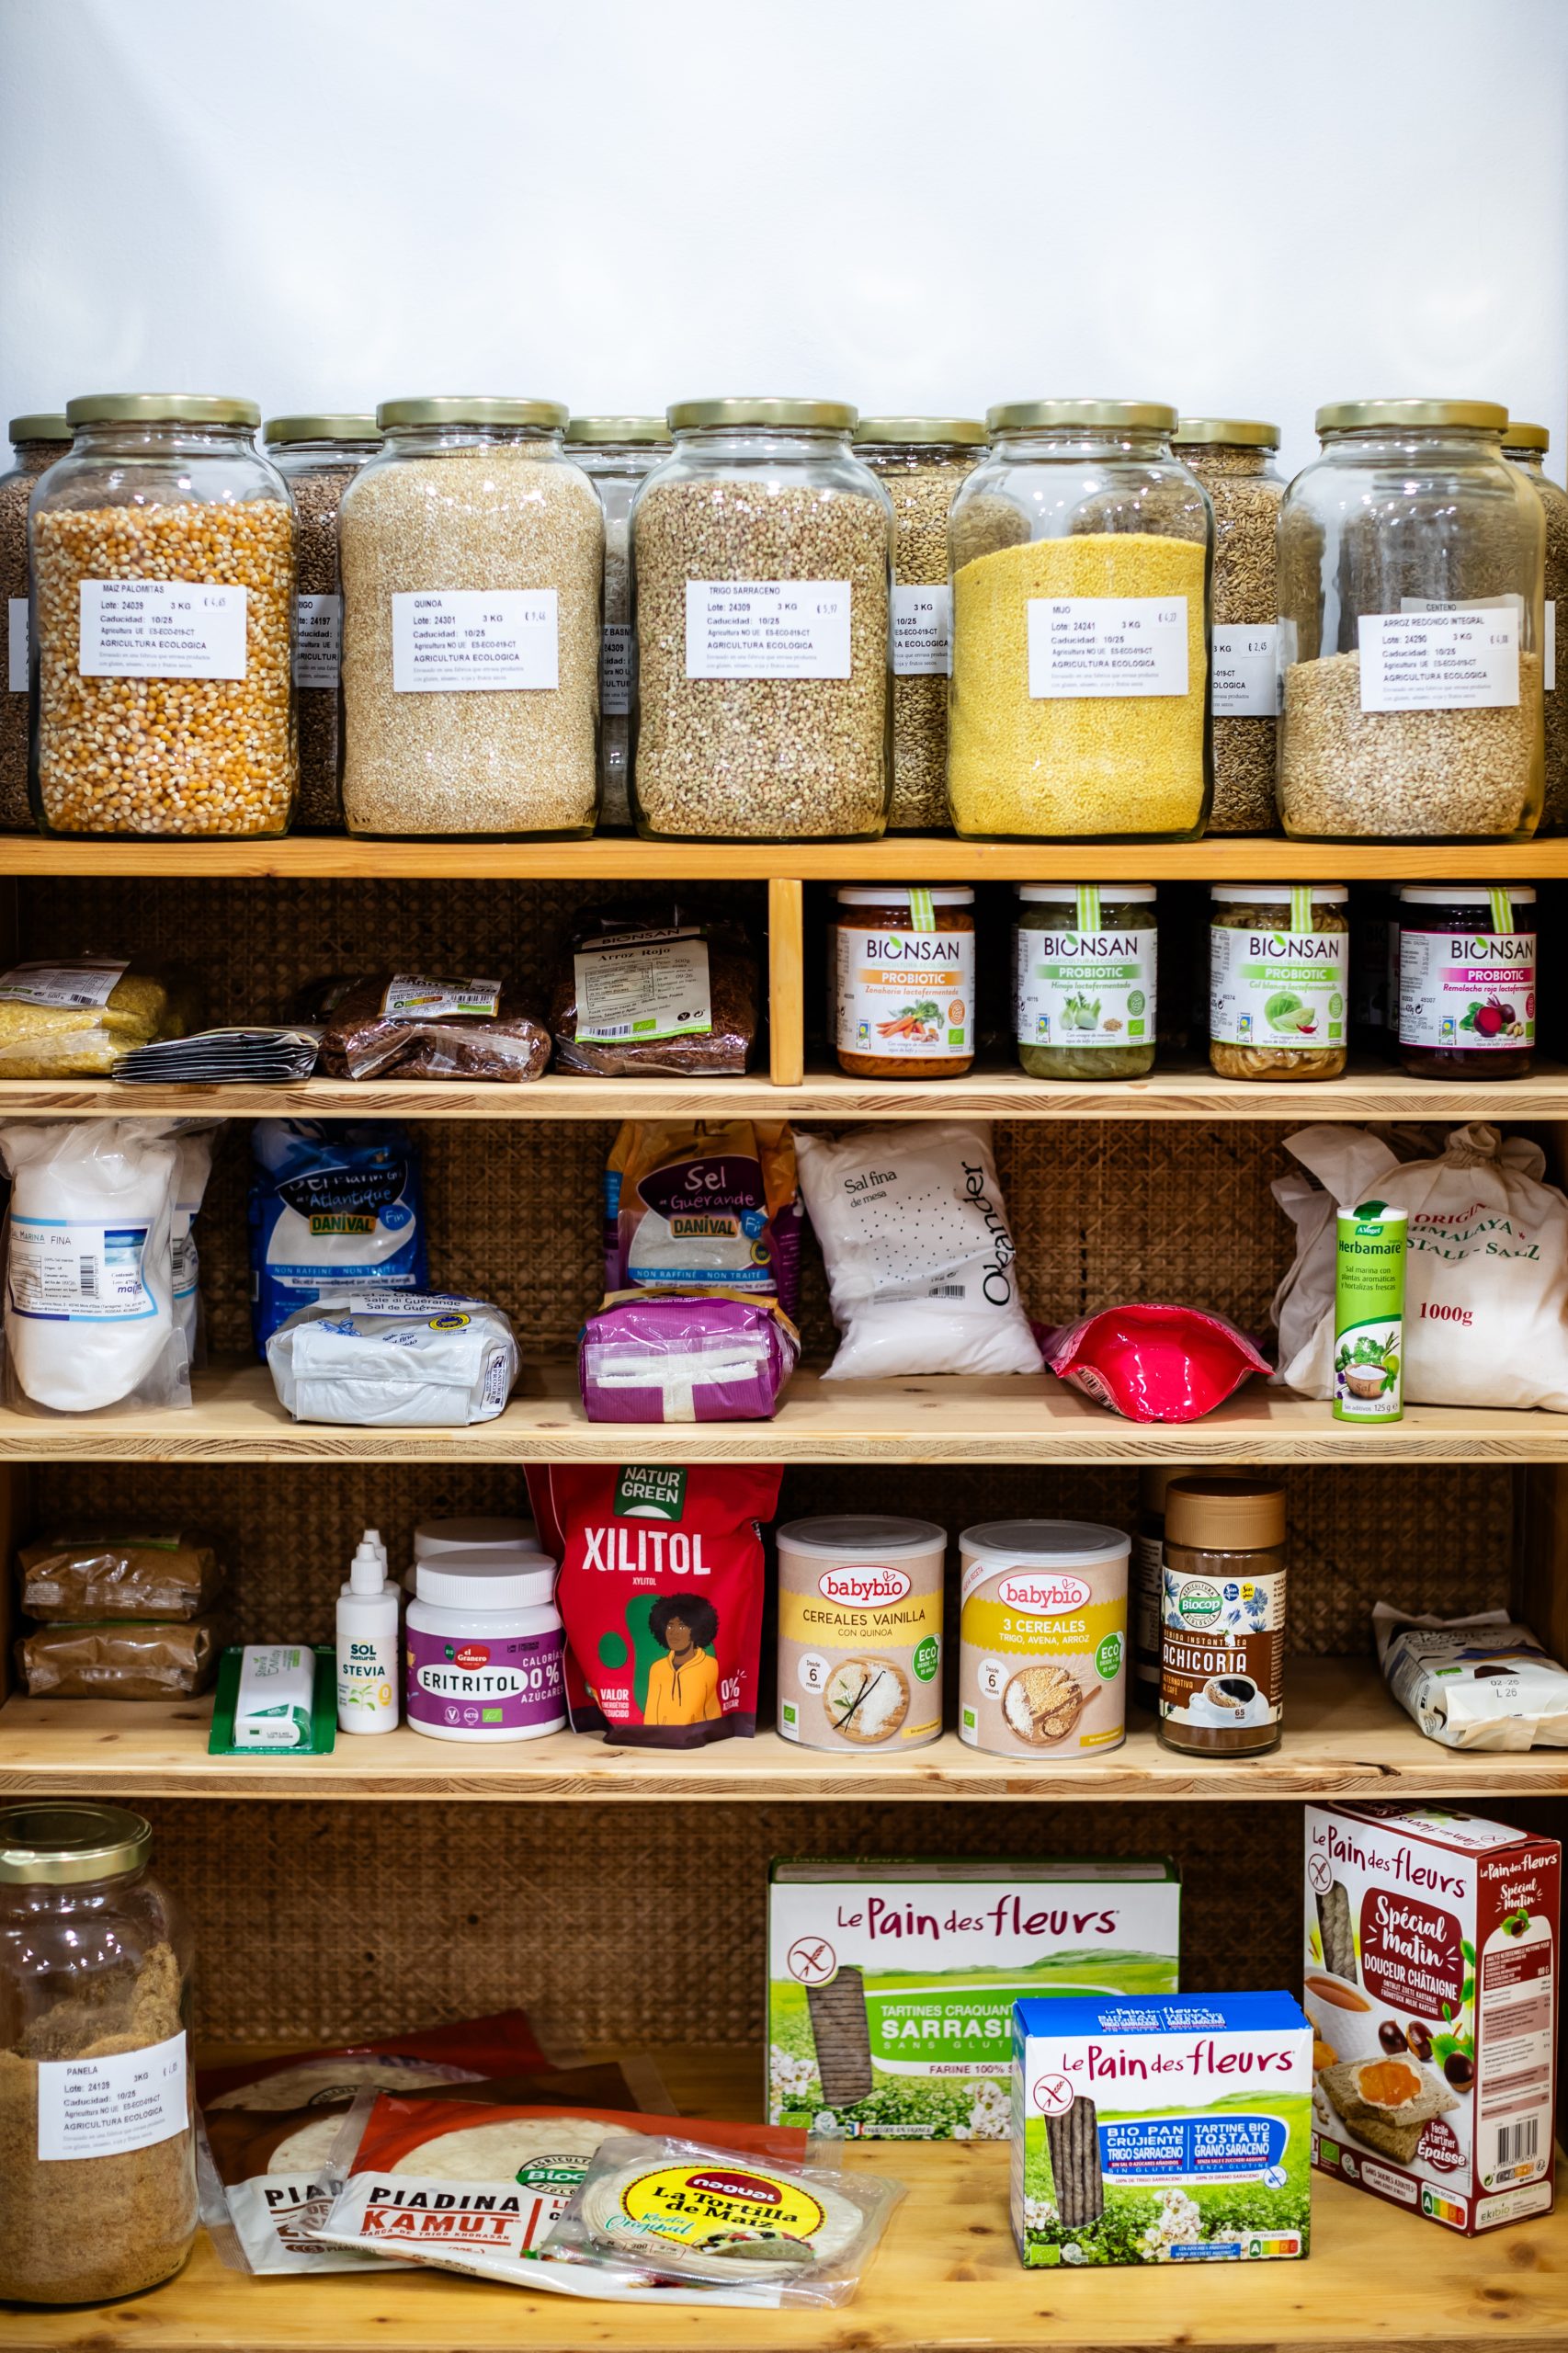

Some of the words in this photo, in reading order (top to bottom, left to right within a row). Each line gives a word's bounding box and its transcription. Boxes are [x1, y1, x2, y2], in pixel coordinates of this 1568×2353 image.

[102, 585, 119, 594] MAIZ
[121, 585, 165, 594] PALOMITAS
[710, 587, 732, 596] TRIGO
[733, 587, 780, 596] SARRACENO
[101, 601, 119, 609] Lote:
[414, 600, 442, 608] QUINOA
[708, 603, 726, 612] Lote:
[729, 603, 751, 612] 24309
[785, 603, 798, 611] KG
[100, 616, 145, 624] Caducidad:
[413, 617, 431, 626] Lote:
[435, 617, 456, 625] 24301
[1074, 622, 1096, 631] 24241
[1383, 619, 1410, 627] ARROZ
[1411, 618, 1449, 626] REDONDO
[708, 629, 740, 637] Agricultura
[100, 640, 156, 648] AGRICULTURA
[159, 641, 207, 650] ECOLOGICA
[707, 642, 764, 650] AGRICULTURA
[767, 642, 812, 650] ECOLOGICA
[414, 654, 470, 663] AGRICULTURA
[472, 654, 520, 662] ECOLOGICA
[1051, 660, 1109, 668] AGRICULTURA
[1112, 660, 1155, 668] ECOLOGICA
[602, 927, 681, 945] BIONSAN
[867, 937, 960, 961] BIONSAN
[1044, 934, 1138, 957] BIONSAN
[1250, 936, 1339, 959] BIONSAN
[1451, 938, 1533, 961] BIONSAN
[599, 952, 633, 961] Arroz
[642, 947, 671, 958] Rojo
[881, 972, 946, 983] PROBIOTIC
[1059, 966, 1123, 979] PROBIOTIC
[1265, 968, 1327, 980] PROBIOTIC
[1468, 970, 1524, 981] PROBIOTIC
[865, 985, 901, 995] Zanahoria
[1443, 983, 1483, 992] Remolacha
[1484, 985, 1497, 995] roja
[685, 1165, 726, 1190] Sel
[844, 1176, 869, 1194] Sal
[869, 1168, 897, 1186] fina
[310, 1188, 392, 1208] Atlantique
[670, 1188, 756, 1210] Guérande
[850, 1197, 862, 1208] de
[863, 1189, 887, 1203] mesa
[385, 1211, 404, 1222] Fin
[19, 1231, 45, 1242] MARINA
[51, 1236, 71, 1245] FINA
[1338, 1240, 1402, 1255] Herbamare
[637, 1270, 656, 1279] NON
[660, 1269, 697, 1279] RAFFINÉ
[707, 1271, 727, 1279] NON
[732, 1270, 760, 1279] TRAITÉ
[1346, 1265, 1354, 1274] Sal
[1355, 1266, 1378, 1274] marina
[1341, 1273, 1360, 1283] plantas
[1362, 1273, 1396, 1282] aromáticas
[1344, 1281, 1373, 1290] hortalizas
[1375, 1282, 1396, 1290] frescas
[1420, 1302, 1473, 1326] 1000g
[1374, 1404, 1385, 1412] 125
[625, 1467, 679, 1487] NATUR
[621, 1482, 678, 1504] GREEN
[582, 1528, 711, 1575] XILITOL
[632, 1577, 657, 1586] XYLITOL
[827, 1576, 903, 1600] babybio
[1006, 1583, 1083, 1608] babybio
[1182, 1599, 1221, 1611] Biocop
[803, 1608, 868, 1626] CEREALES
[873, 1608, 926, 1625] VAINILLA
[1004, 1619, 1012, 1631] 3
[1016, 1620, 1085, 1633] CEREALES
[838, 1629, 858, 1637] CON
[860, 1629, 892, 1637] QUINOA
[999, 1633, 1024, 1644] TRIGO,
[1028, 1636, 1060, 1646] AVENA,
[1062, 1634, 1090, 1643] ARROZ
[351, 1643, 377, 1655] SOL
[919, 1648, 937, 1662] ECO
[1102, 1644, 1119, 1657] ECO
[457, 1654, 487, 1663] Granero
[523, 1651, 563, 1666] CALORÍAS
[1163, 1643, 1247, 1673] ACHICORIA
[343, 1664, 385, 1677] STEVIA
[809, 1668, 818, 1682] 6
[423, 1671, 519, 1693] ERITRITOL
[722, 1677, 740, 1700] 0%
[521, 1685, 563, 1704] AZÚCARES
[600, 1688, 630, 1701] VALOR
[1312, 1826, 1326, 1846] Le
[1328, 1825, 1366, 1871] Pain
[1368, 1850, 1390, 1871] des
[1392, 1847, 1465, 1898] fleurs
[1488, 1863, 1509, 1881] Pain
[1520, 1853, 1558, 1871] fleurs
[1500, 1877, 1538, 1900] Spécial
[838, 1905, 863, 1928] Le
[869, 1897, 940, 1939] Pain
[944, 1909, 984, 1932] des
[987, 1894, 1117, 1937] fleurs
[1375, 1895, 1447, 1942] Spécial
[1365, 1953, 1406, 1984] DOUCEUR
[1407, 1969, 1458, 2001] CHÂTAIGNE
[881, 2006, 941, 2016] TARTINES
[1063, 2053, 1085, 2072] Le
[1088, 2045, 1148, 2081] Pain
[1151, 2054, 1184, 2071] des
[1187, 2040, 1293, 2075] fleurs
[66, 2066, 98, 2075] PANELA
[929, 2065, 971, 2075] FARINE
[975, 2064, 1005, 2074] 100%
[63, 2118, 122, 2131] AGRICULTURA
[124, 2106, 164, 2123] ECOLOGICA
[1108, 2127, 1140, 2137] BIO
[1148, 2126, 1184, 2136] PAN
[1195, 2124, 1246, 2133] TARTINE
[1249, 2123, 1270, 2131] BIO
[1431, 2122, 1449, 2136] Facile
[1107, 2136, 1183, 2146] CRUJIENTE
[1195, 2133, 1270, 2143] TOSTATE
[1431, 2133, 1455, 2149] tartiner
[1108, 2149, 1132, 2160] TRIGO
[1133, 2148, 1183, 2159] SARRACENO
[1195, 2145, 1224, 2156] GRANO
[1225, 2143, 1269, 2155] SARACENO
[1417, 2137, 1465, 2166] Épaisse
[369, 2187, 520, 2212] PIADINA
[653, 2187, 686, 2200] La
[694, 2192, 798, 2222] Tortilla
[665, 2200, 699, 2213] de
[703, 2207, 774, 2228] Maíz
[361, 2211, 513, 2234] KAMUT
[606, 2215, 694, 2234] Original
[359, 2228, 393, 2236] MARCA
[453, 2232, 510, 2240] KHORASAN
